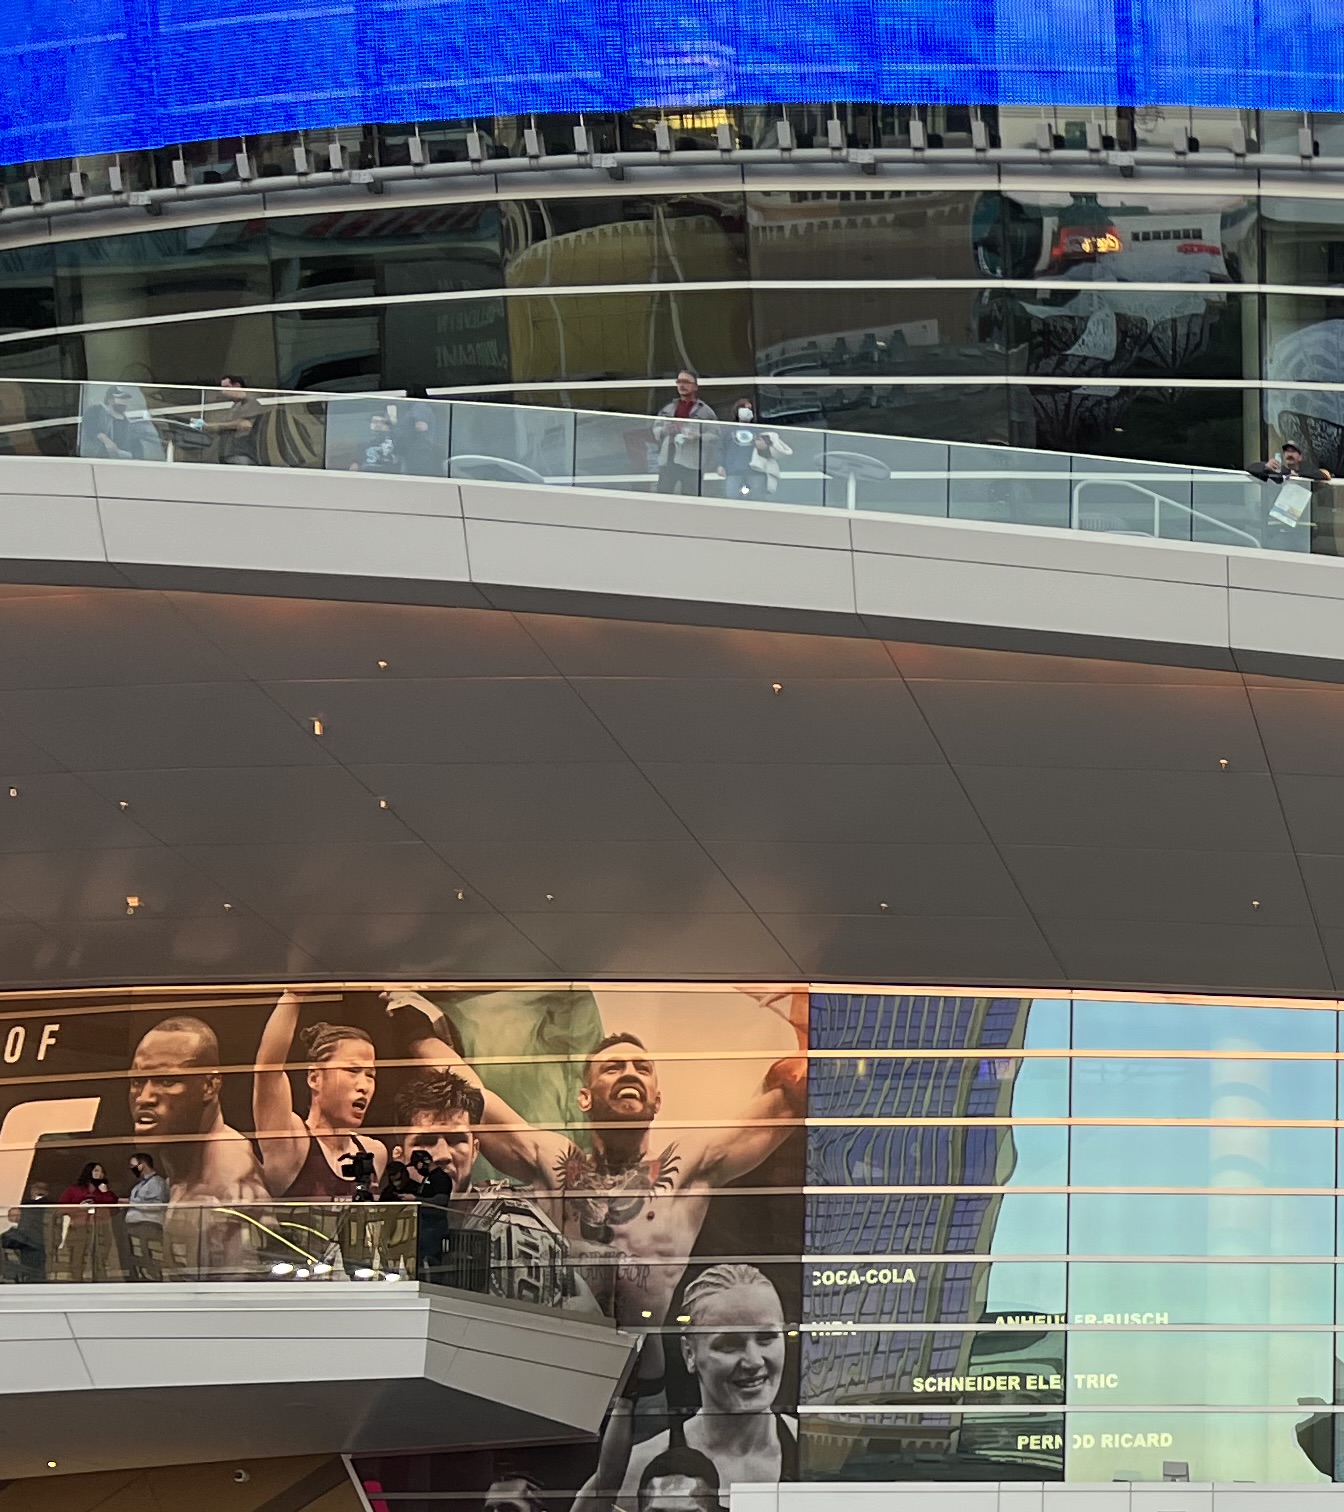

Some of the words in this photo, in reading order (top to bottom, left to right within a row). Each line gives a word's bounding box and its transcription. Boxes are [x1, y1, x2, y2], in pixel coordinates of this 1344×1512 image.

[3, 1023, 60, 1064] OF
[912, 1376, 1021, 1392] SCHNEIDER
[1101, 1432, 1173, 1448] RICARD
